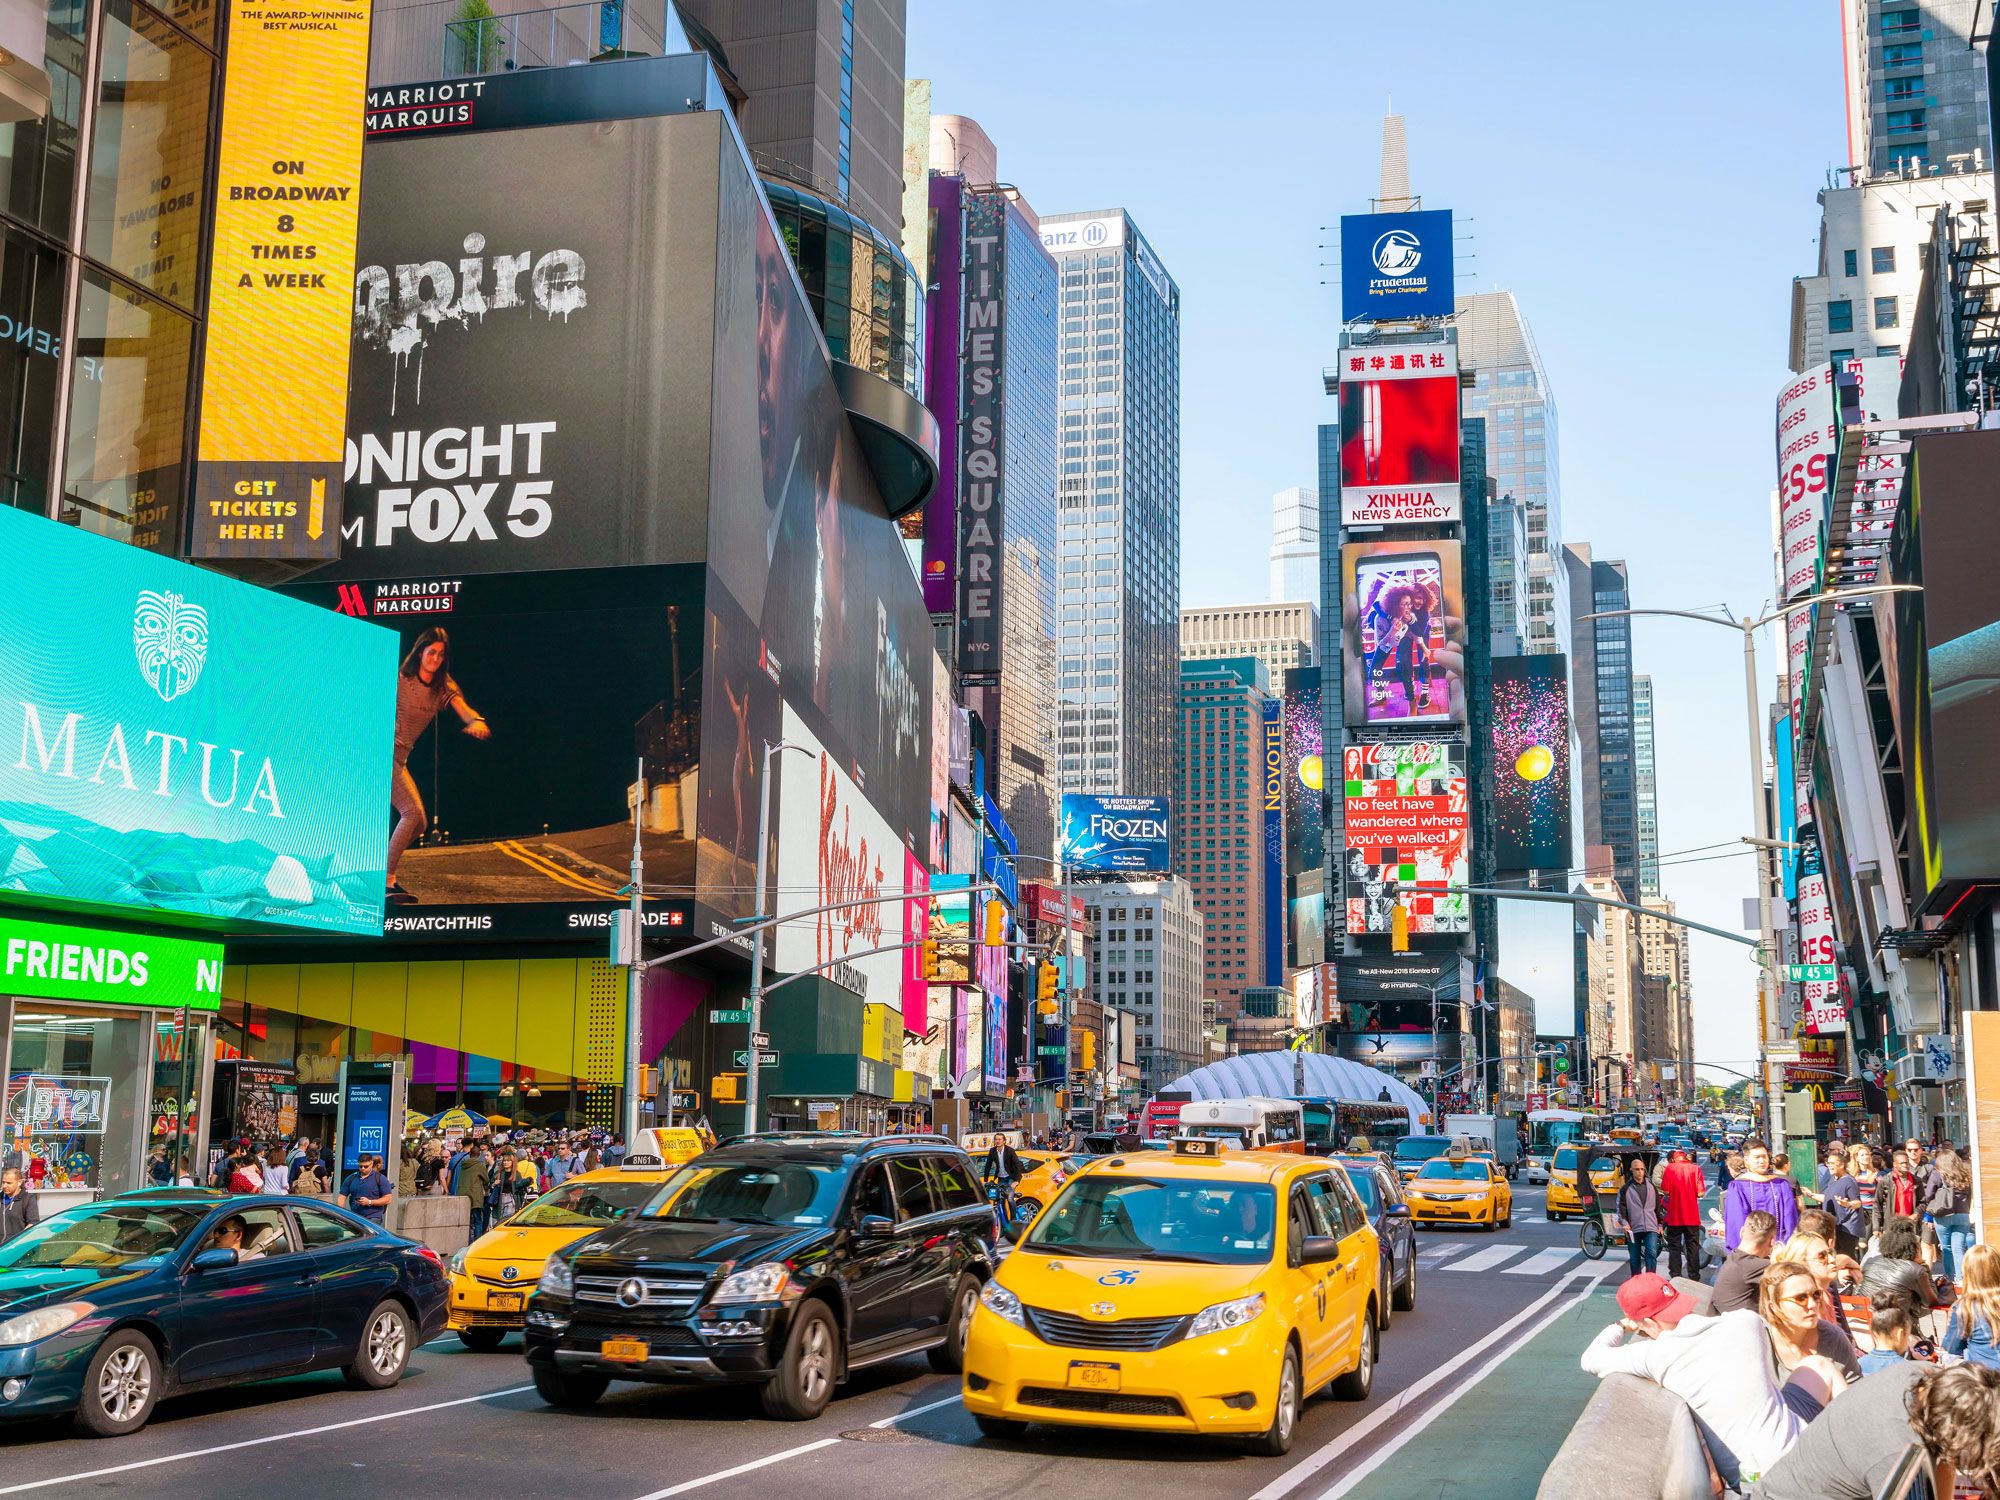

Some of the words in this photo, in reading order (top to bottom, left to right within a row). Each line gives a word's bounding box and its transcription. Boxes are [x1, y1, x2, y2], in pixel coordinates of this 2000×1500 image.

[241, 11, 263, 20] THE
[265, 11, 364, 20] AWARD-WINNING
[263, 22, 287, 31] BEST
[289, 22, 338, 31] MUSICAL
[367, 81, 486, 108] MARRIOTT
[366, 105, 469, 131] MARQUIS
[272, 160, 305, 175] ON
[229, 186, 351, 201] BROADWAY
[277, 215, 295, 233] 8
[251, 245, 317, 260] TIMES
[238, 273, 254, 288] A
[263, 273, 326, 288] WEEK
[1369, 277, 1427, 288] Prudential
[968, 236, 998, 397] TIMES
[1350, 353, 1445, 372] 新华通讯社
[233, 480, 277, 496] GET
[1367, 492, 1436, 508] XINHUA
[209, 501, 297, 518] TICKETS
[376, 482, 499, 546] FOX
[506, 480, 554, 538] 5
[966, 414, 998, 618] SQUARE
[1352, 508, 1392, 521] NEWS
[1395, 506, 1451, 519] AGENCY
[218, 523, 285, 540] HERE!
[377, 581, 462, 596] MARRIOTT
[376, 597, 452, 613] MARQUIS
[967, 642, 991, 652] NYC
[1371, 679, 1390, 688] low
[13, 701, 287, 819] MATUA
[1264, 712, 1281, 811] NOVOTEL
[1348, 800, 1368, 811] No
[1371, 798, 1399, 811] feet
[1402, 798, 1435, 810] have
[1090, 814, 1167, 842] FROZEN
[1348, 815, 1417, 828] wandered
[1420, 814, 1463, 826] where
[1397, 831, 1449, 845] walked,
[384, 915, 492, 931] #SWATCHTHIS
[640, 912, 669, 926] ADE
[6, 938, 149, 987] FRIENDS
[196, 958, 222, 993] N
[1791, 967, 1802, 980] W
[1807, 966, 1821, 979] 45
[1824, 966, 1832, 975] St
[842, 962, 869, 997] BROADWAY
[720, 1012, 727, 1022] W
[730, 1012, 740, 1021] 45
[34, 1088, 101, 1121] BT21
[361, 1129, 381, 1139] NYC
[361, 1139, 380, 1150] 311
[632, 1156, 651, 1165] 8N61
